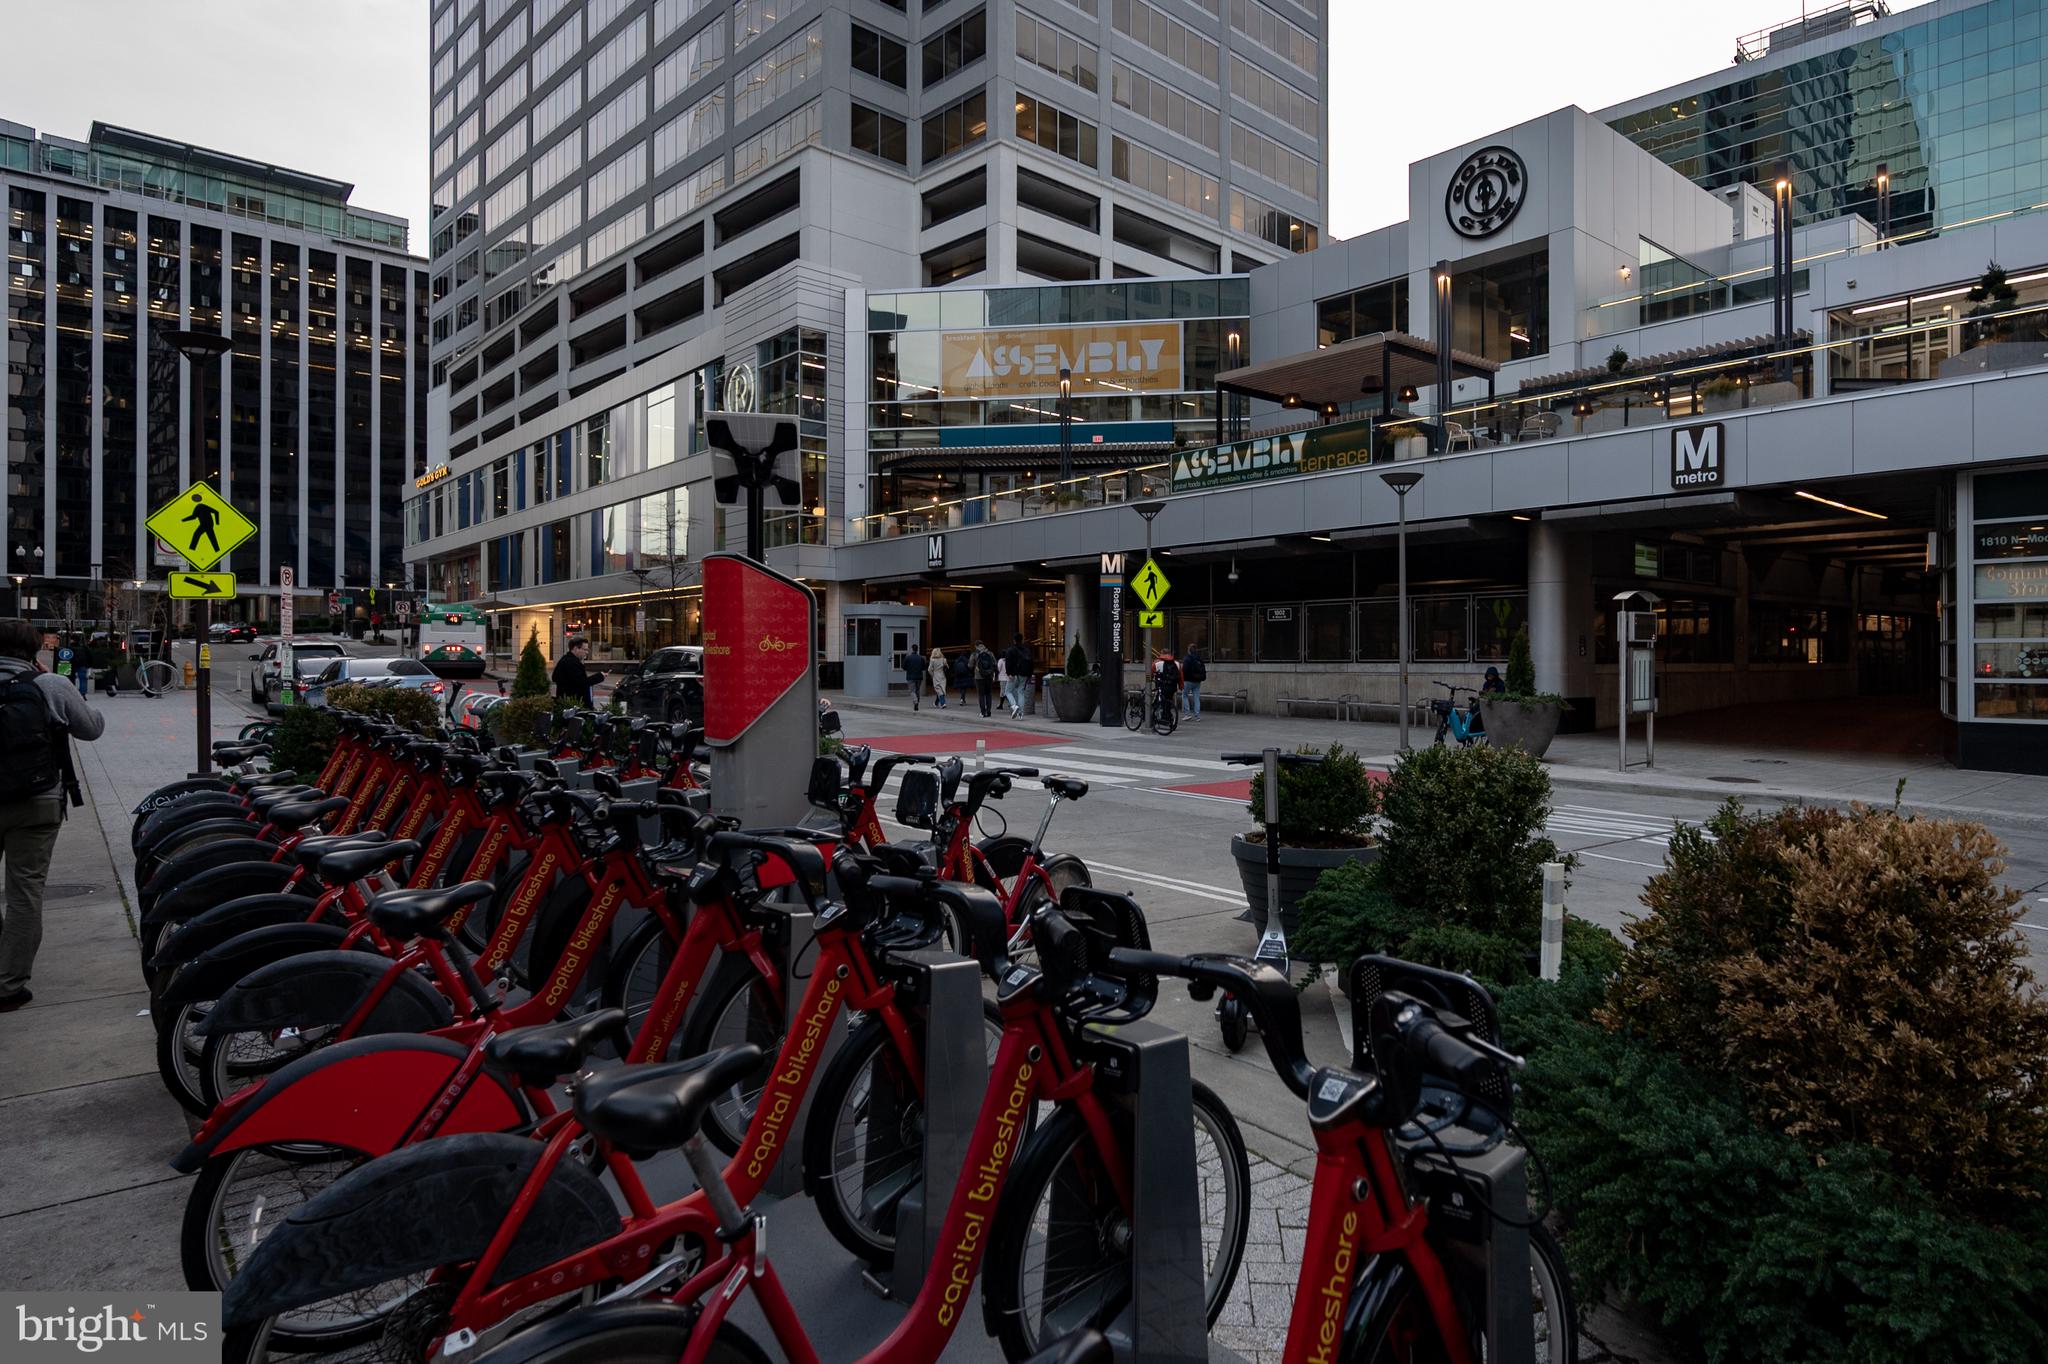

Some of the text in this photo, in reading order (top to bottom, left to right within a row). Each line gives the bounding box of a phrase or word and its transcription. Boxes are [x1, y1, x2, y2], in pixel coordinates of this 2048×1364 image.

[1453, 154, 1520, 204] GOLD'S
[1459, 196, 1516, 230] GYM
[966, 339, 1165, 378] ASSEMBLY
[1173, 432, 1307, 481] ASSEMBLY
[1300, 448, 1368, 473] terrace
[1676, 426, 1718, 471] M
[1676, 471, 1717, 485] metro
[929, 536, 942, 559] M
[1101, 553, 1121, 574] M
[1980, 535, 2007, 546] 1810
[1112, 587, 1121, 653] Rosslyn Station
[373, 777, 407, 820] bikeshare
[398, 792, 432, 839] bikeshare
[428, 808, 465, 859] bikeshare
[470, 831, 503, 881] ikeshare
[487, 852, 556, 969] capital bikeshare
[545, 882, 620, 1007] capital bikeshare
[747, 979, 840, 1179] capital bikeshare
[938, 1062, 1034, 1327] capital bikeshare
[1306, 1210, 1358, 1364] keshare
